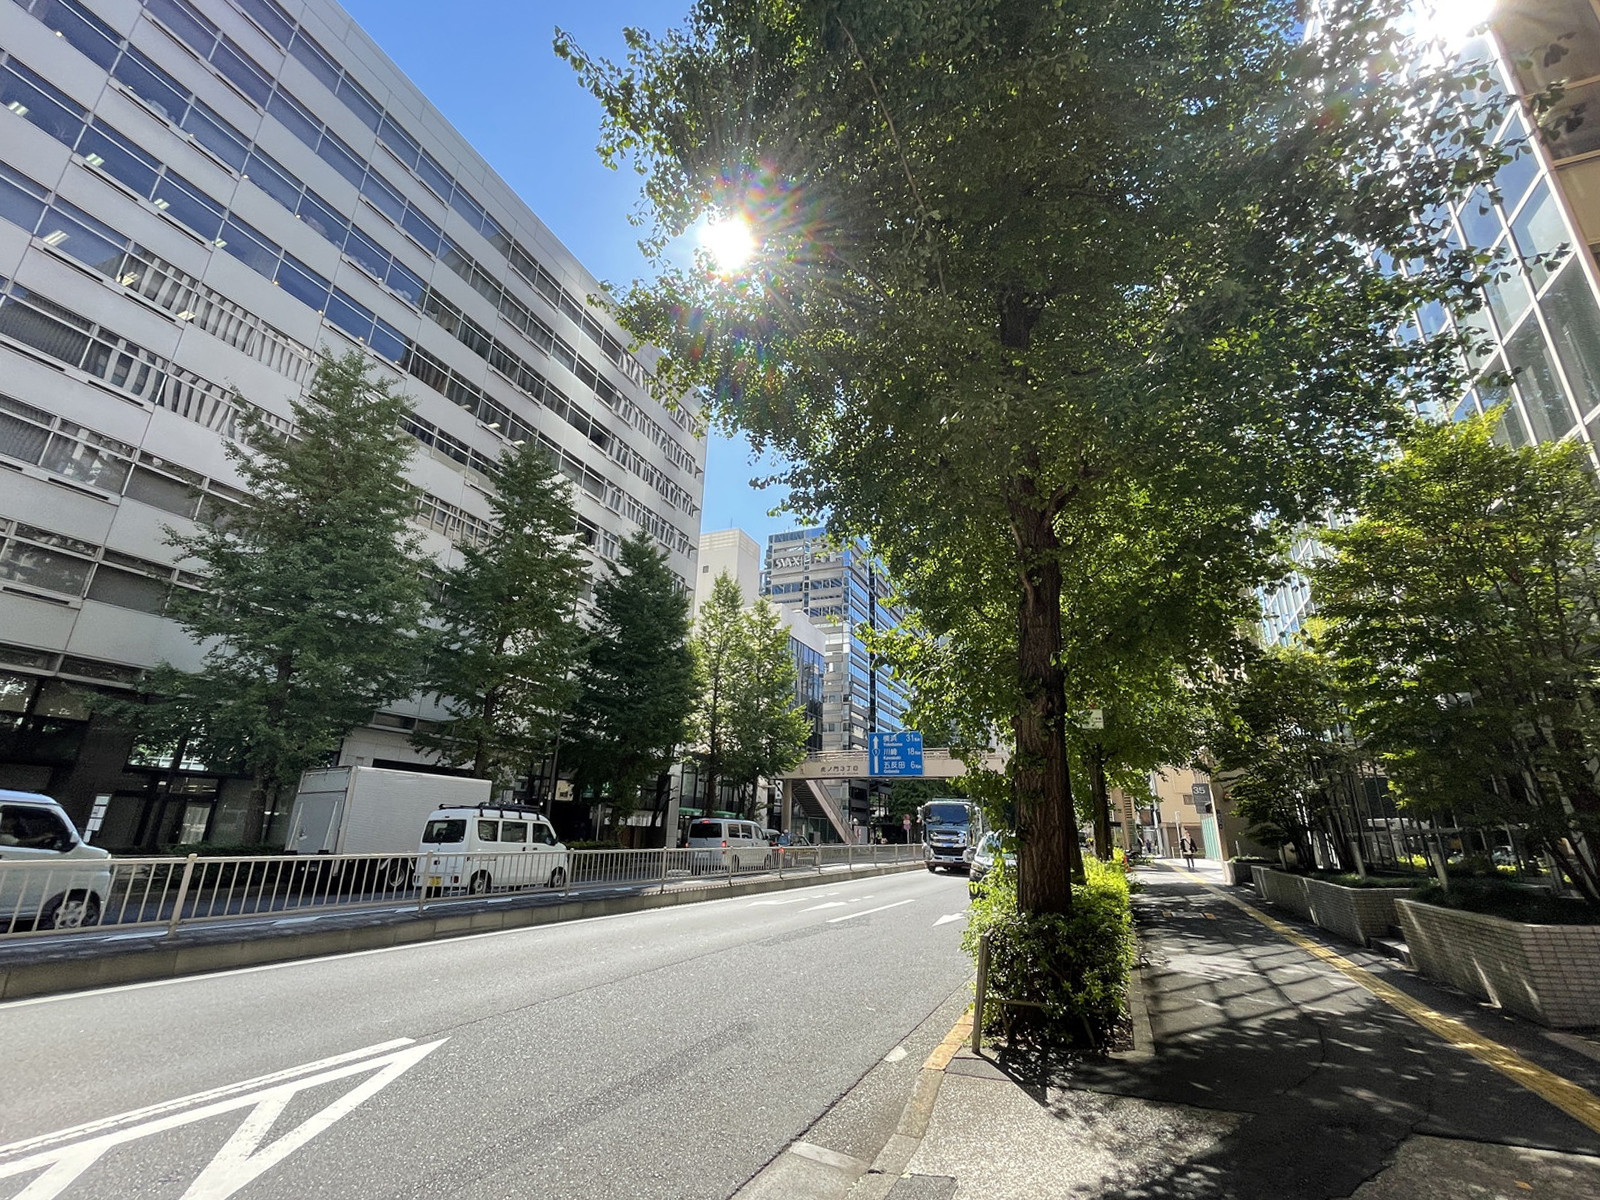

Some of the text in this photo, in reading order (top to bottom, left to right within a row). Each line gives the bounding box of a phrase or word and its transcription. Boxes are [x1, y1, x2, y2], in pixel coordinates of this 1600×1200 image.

[884, 761, 905, 769] 五反田
[1192, 786, 1205, 794] 35
